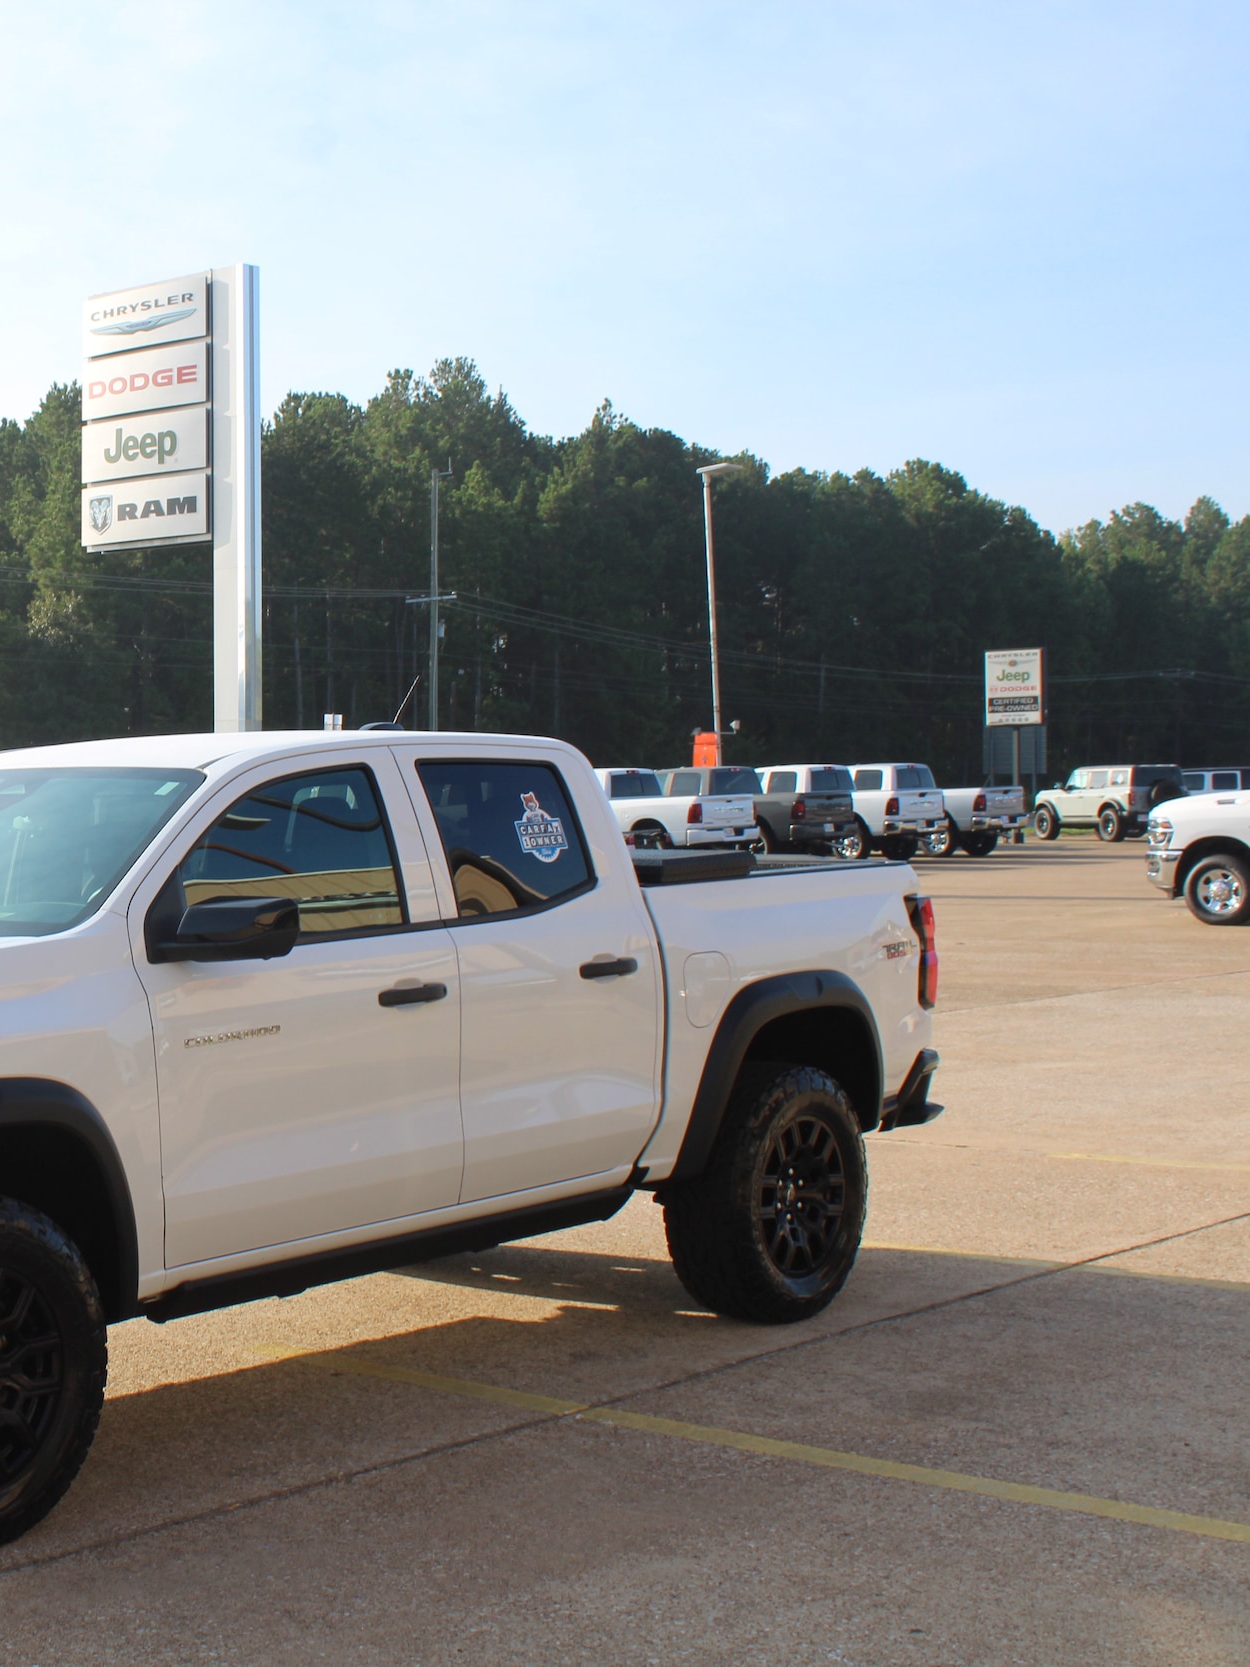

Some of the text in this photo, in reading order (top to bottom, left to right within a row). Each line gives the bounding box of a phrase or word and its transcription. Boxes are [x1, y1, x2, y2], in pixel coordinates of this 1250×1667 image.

[90, 292, 194, 322] CHRYSLER
[88, 364, 198, 400] DODGE
[104, 427, 178, 464] Jeep
[117, 495, 198, 522] RAM
[996, 669, 1031, 683] Jeep
[988, 703, 1038, 712] PRE-OWNED
[992, 697, 1034, 705] CERTIFIED
[520, 824, 560, 835] CARFAX
[882, 940, 918, 953] TRAIL
